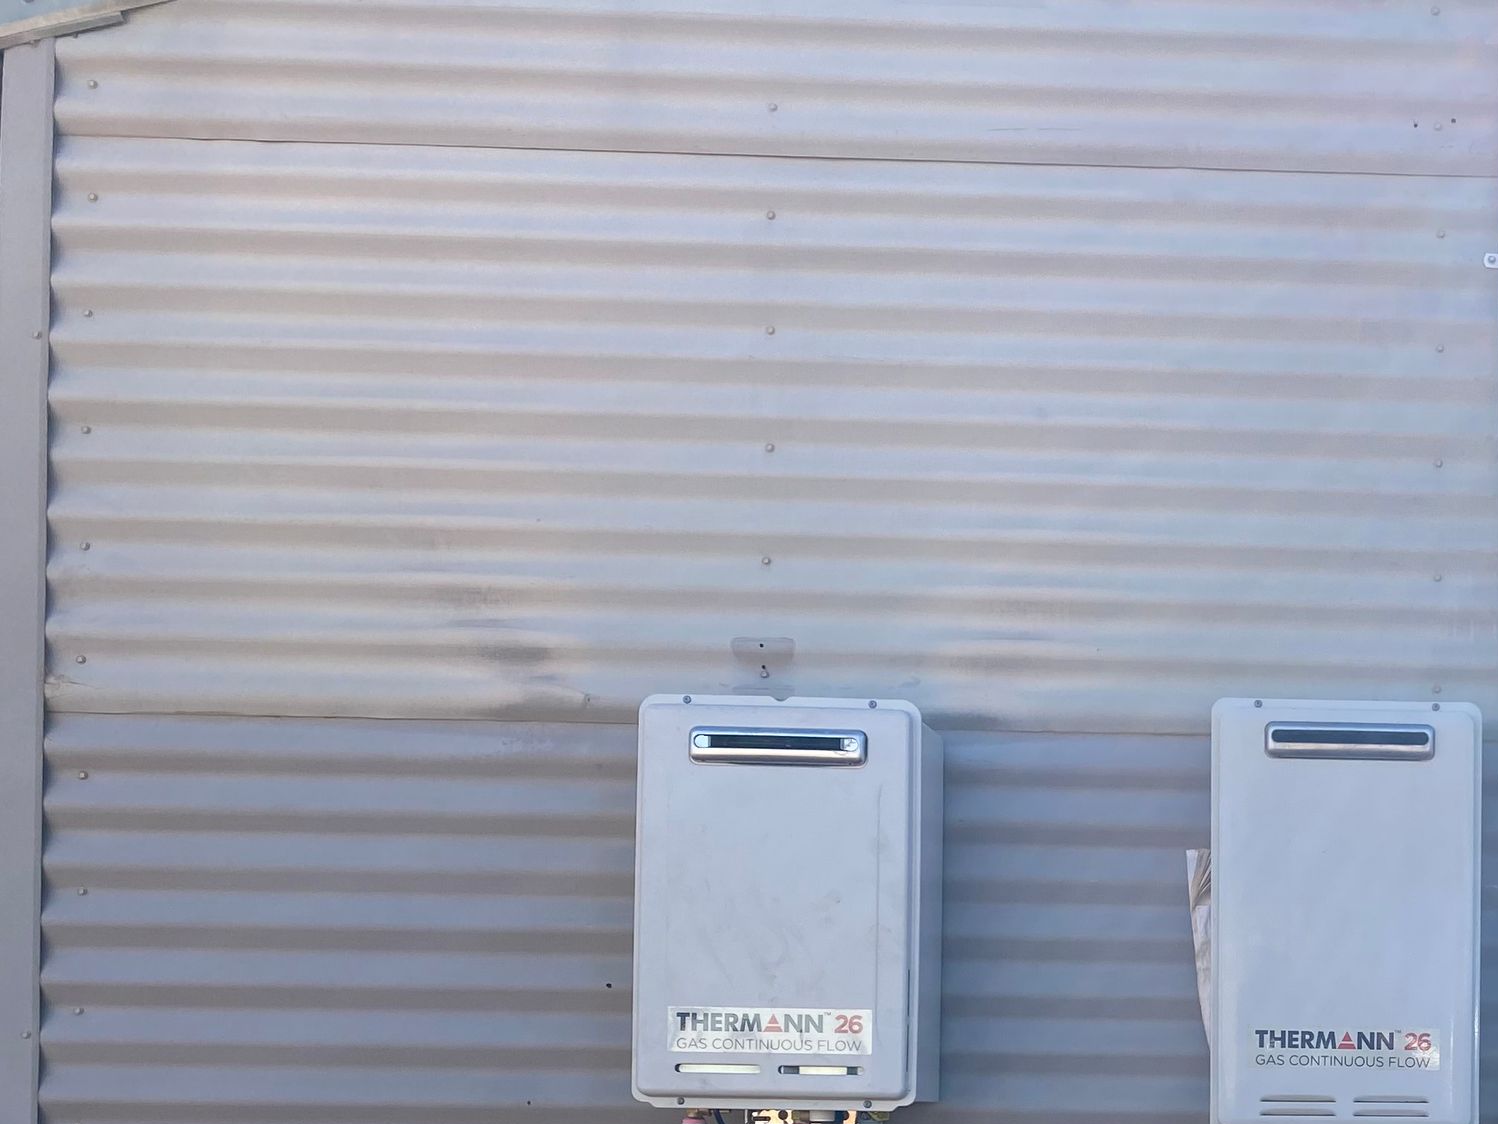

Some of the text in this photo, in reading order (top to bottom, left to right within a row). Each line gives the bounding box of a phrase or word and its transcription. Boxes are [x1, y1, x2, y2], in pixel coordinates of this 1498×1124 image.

[834, 1014, 864, 1034] 26
[676, 1037, 862, 1052] GAS CONTINUOUS FLOW
[1404, 1032, 1432, 1052] 26
[1255, 1054, 1431, 1068] GAS CONTINUOUS FLOW
